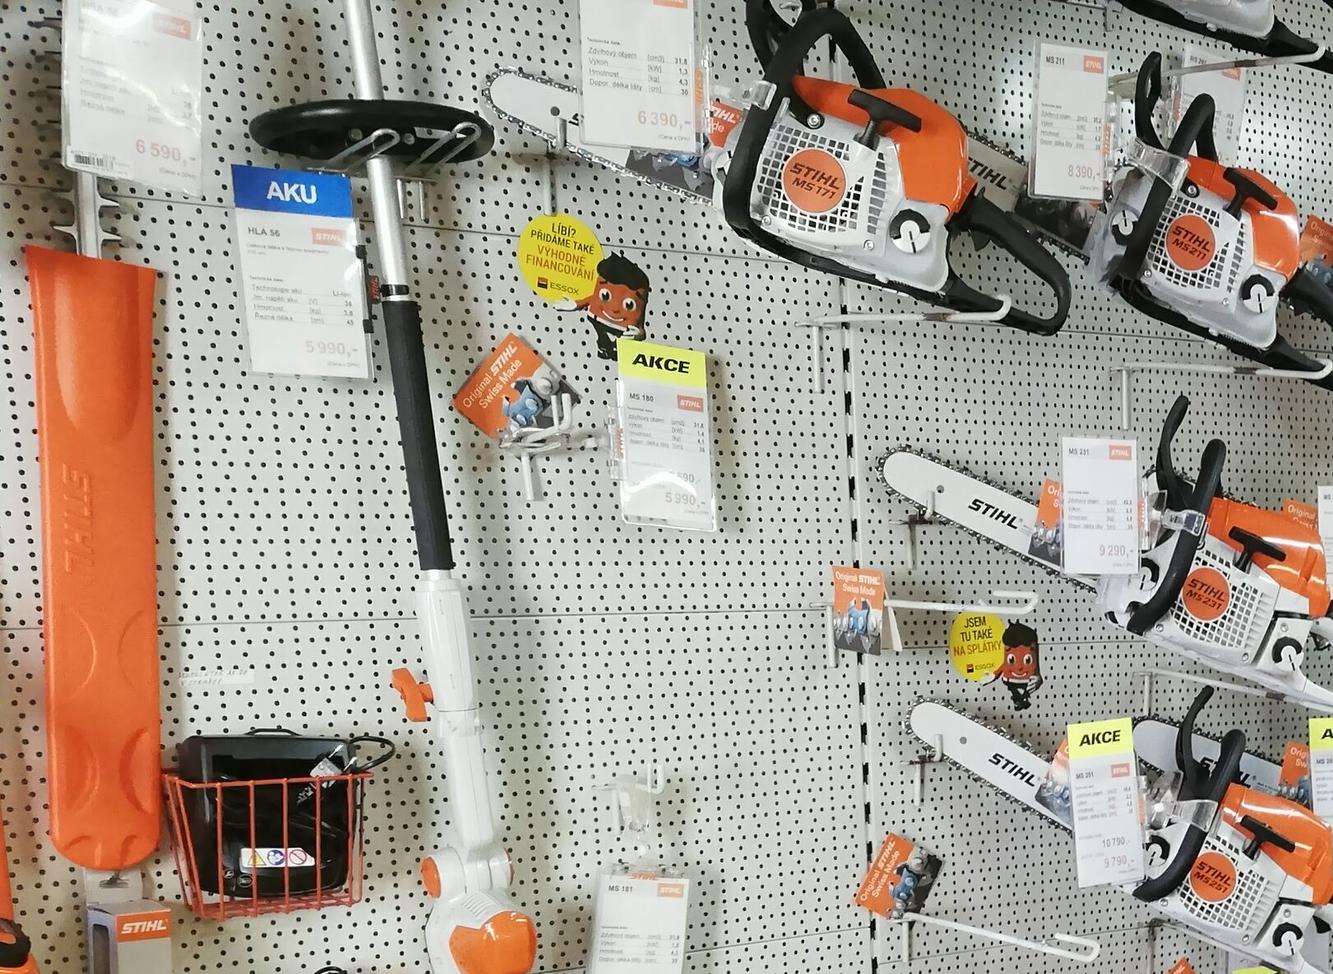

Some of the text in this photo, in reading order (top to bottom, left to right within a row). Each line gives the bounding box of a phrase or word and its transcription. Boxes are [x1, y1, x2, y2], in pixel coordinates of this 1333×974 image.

[638, 111, 691, 130] 6 390,-
[711, 105, 736, 124] TIHL
[136, 139, 145, 154] 6
[789, 163, 842, 192] STIHL
[267, 181, 318, 204] AKU
[551, 222, 577, 237] LÍBÍ?
[1172, 225, 1212, 253] STIHL
[530, 228, 595, 255] PŘIDÁME TAKÉ
[537, 244, 586, 267] VÝHODNÉ
[526, 254, 595, 281] FINANCOVÁNÍ
[550, 282, 580, 295] ESSOX
[305, 340, 314, 352] 5
[632, 353, 690, 374] AKCE
[463, 342, 518, 409] Original STIHL
[479, 359, 522, 409] Swiss Made
[968, 498, 1020, 531] STIHL
[1100, 545, 1106, 556] 9
[1188, 578, 1225, 603] STIHL
[964, 616, 987, 628] JSEM
[960, 628, 993, 642] TU TAKÉ
[953, 640, 1002, 656] NA SPLÁTKY
[1079, 730, 1121, 746] AKCE
[988, 752, 1036, 787] STIHL
[878, 840, 896, 868] STIHL
[1196, 861, 1232, 886] STIHL
[121, 920, 167, 934] STIHL
